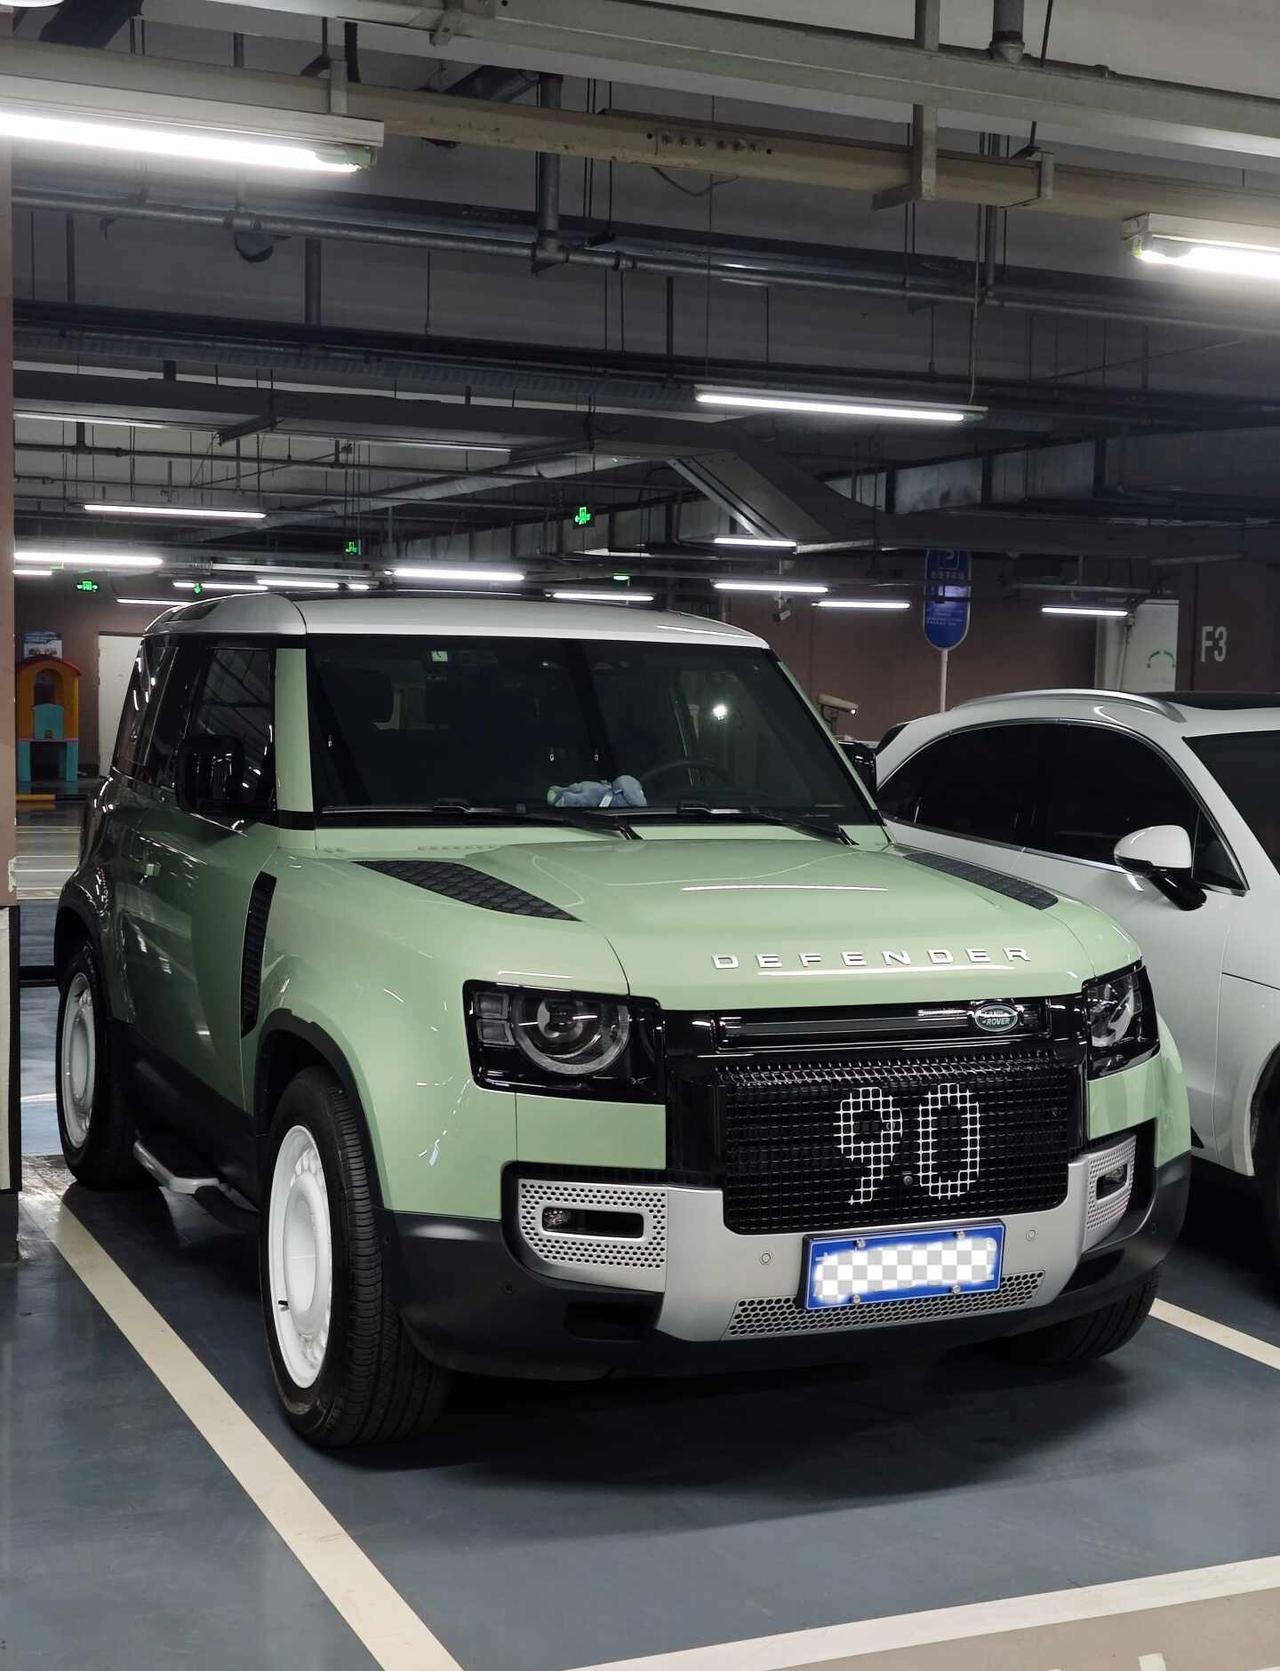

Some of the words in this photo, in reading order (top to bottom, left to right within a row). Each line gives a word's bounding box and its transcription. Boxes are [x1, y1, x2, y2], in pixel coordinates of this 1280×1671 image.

[1200, 625, 1228, 663] F3
[711, 946, 1032, 970] DEFENDER
[986, 1017, 1010, 1026] ROVER
[833, 1082, 981, 1205] 90
